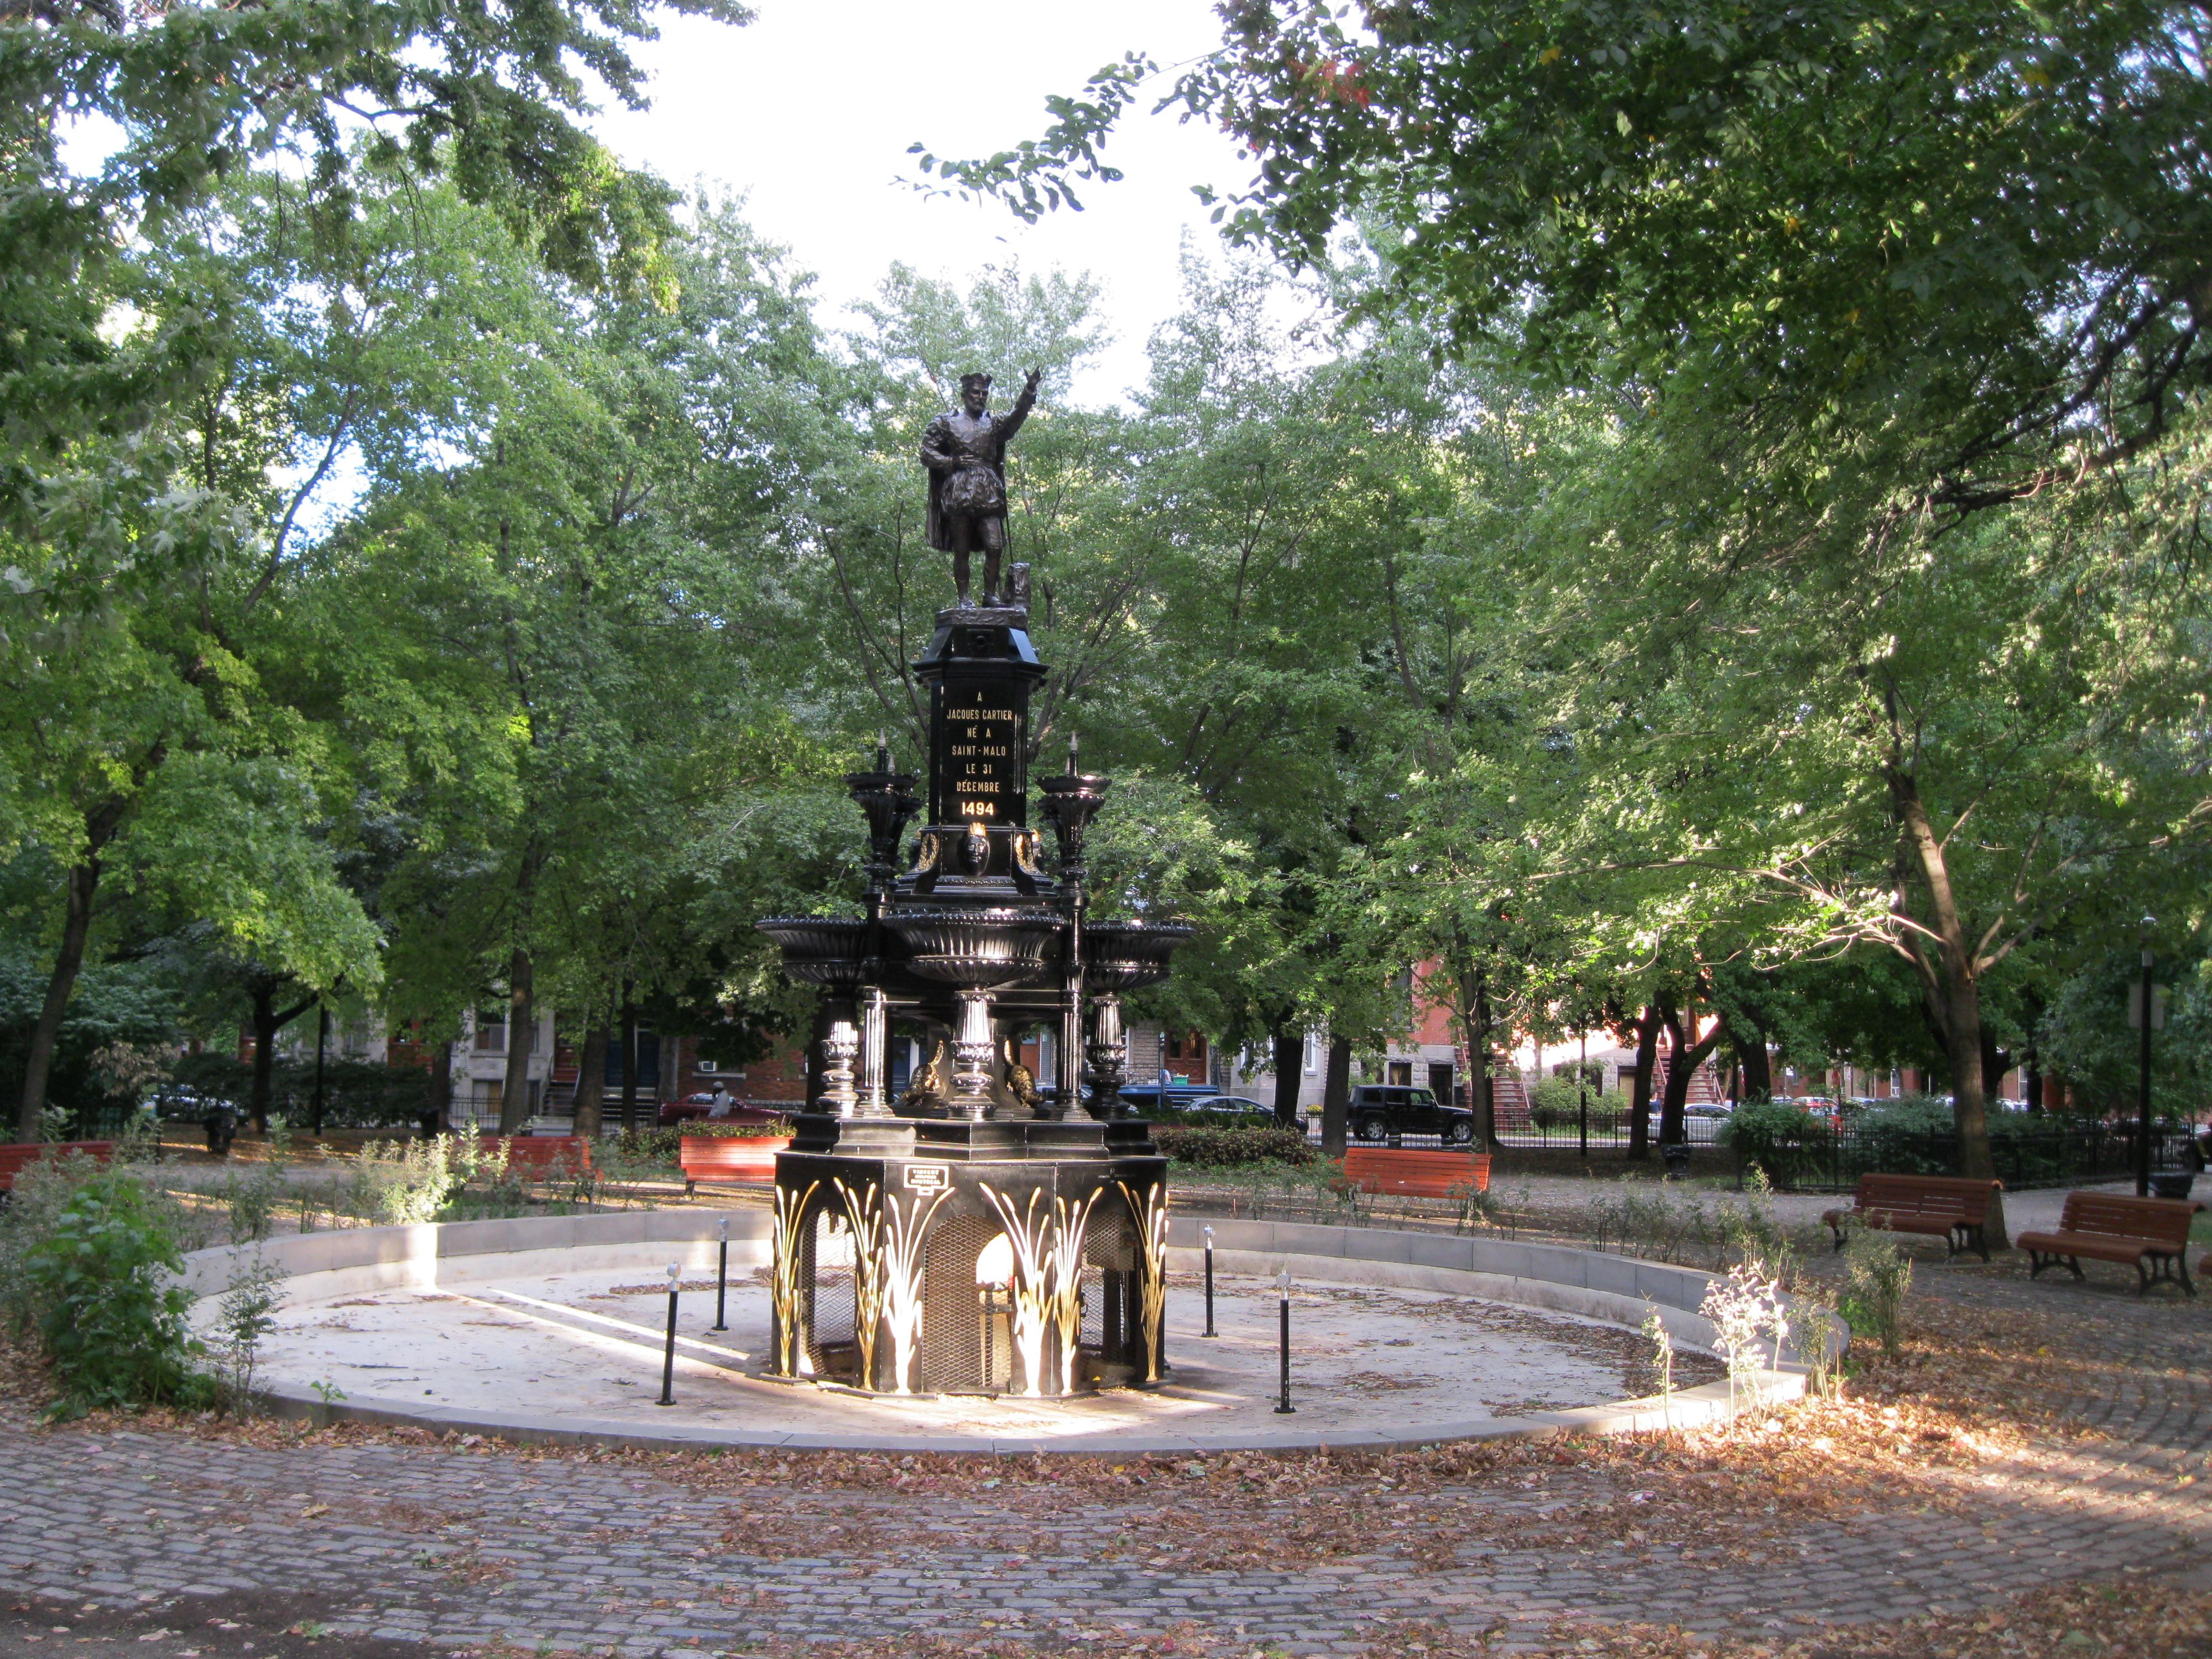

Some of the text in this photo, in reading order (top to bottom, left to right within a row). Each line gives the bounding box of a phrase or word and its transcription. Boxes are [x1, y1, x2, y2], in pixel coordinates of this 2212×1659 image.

[977, 692, 982, 702] A
[947, 709, 1013, 720] JACQUES CARTIER
[967, 726, 991, 738] NÉ A
[967, 764, 992, 774] LE 31
[957, 779, 999, 792] DÉCEMBRE
[962, 802, 994, 816] 1494
